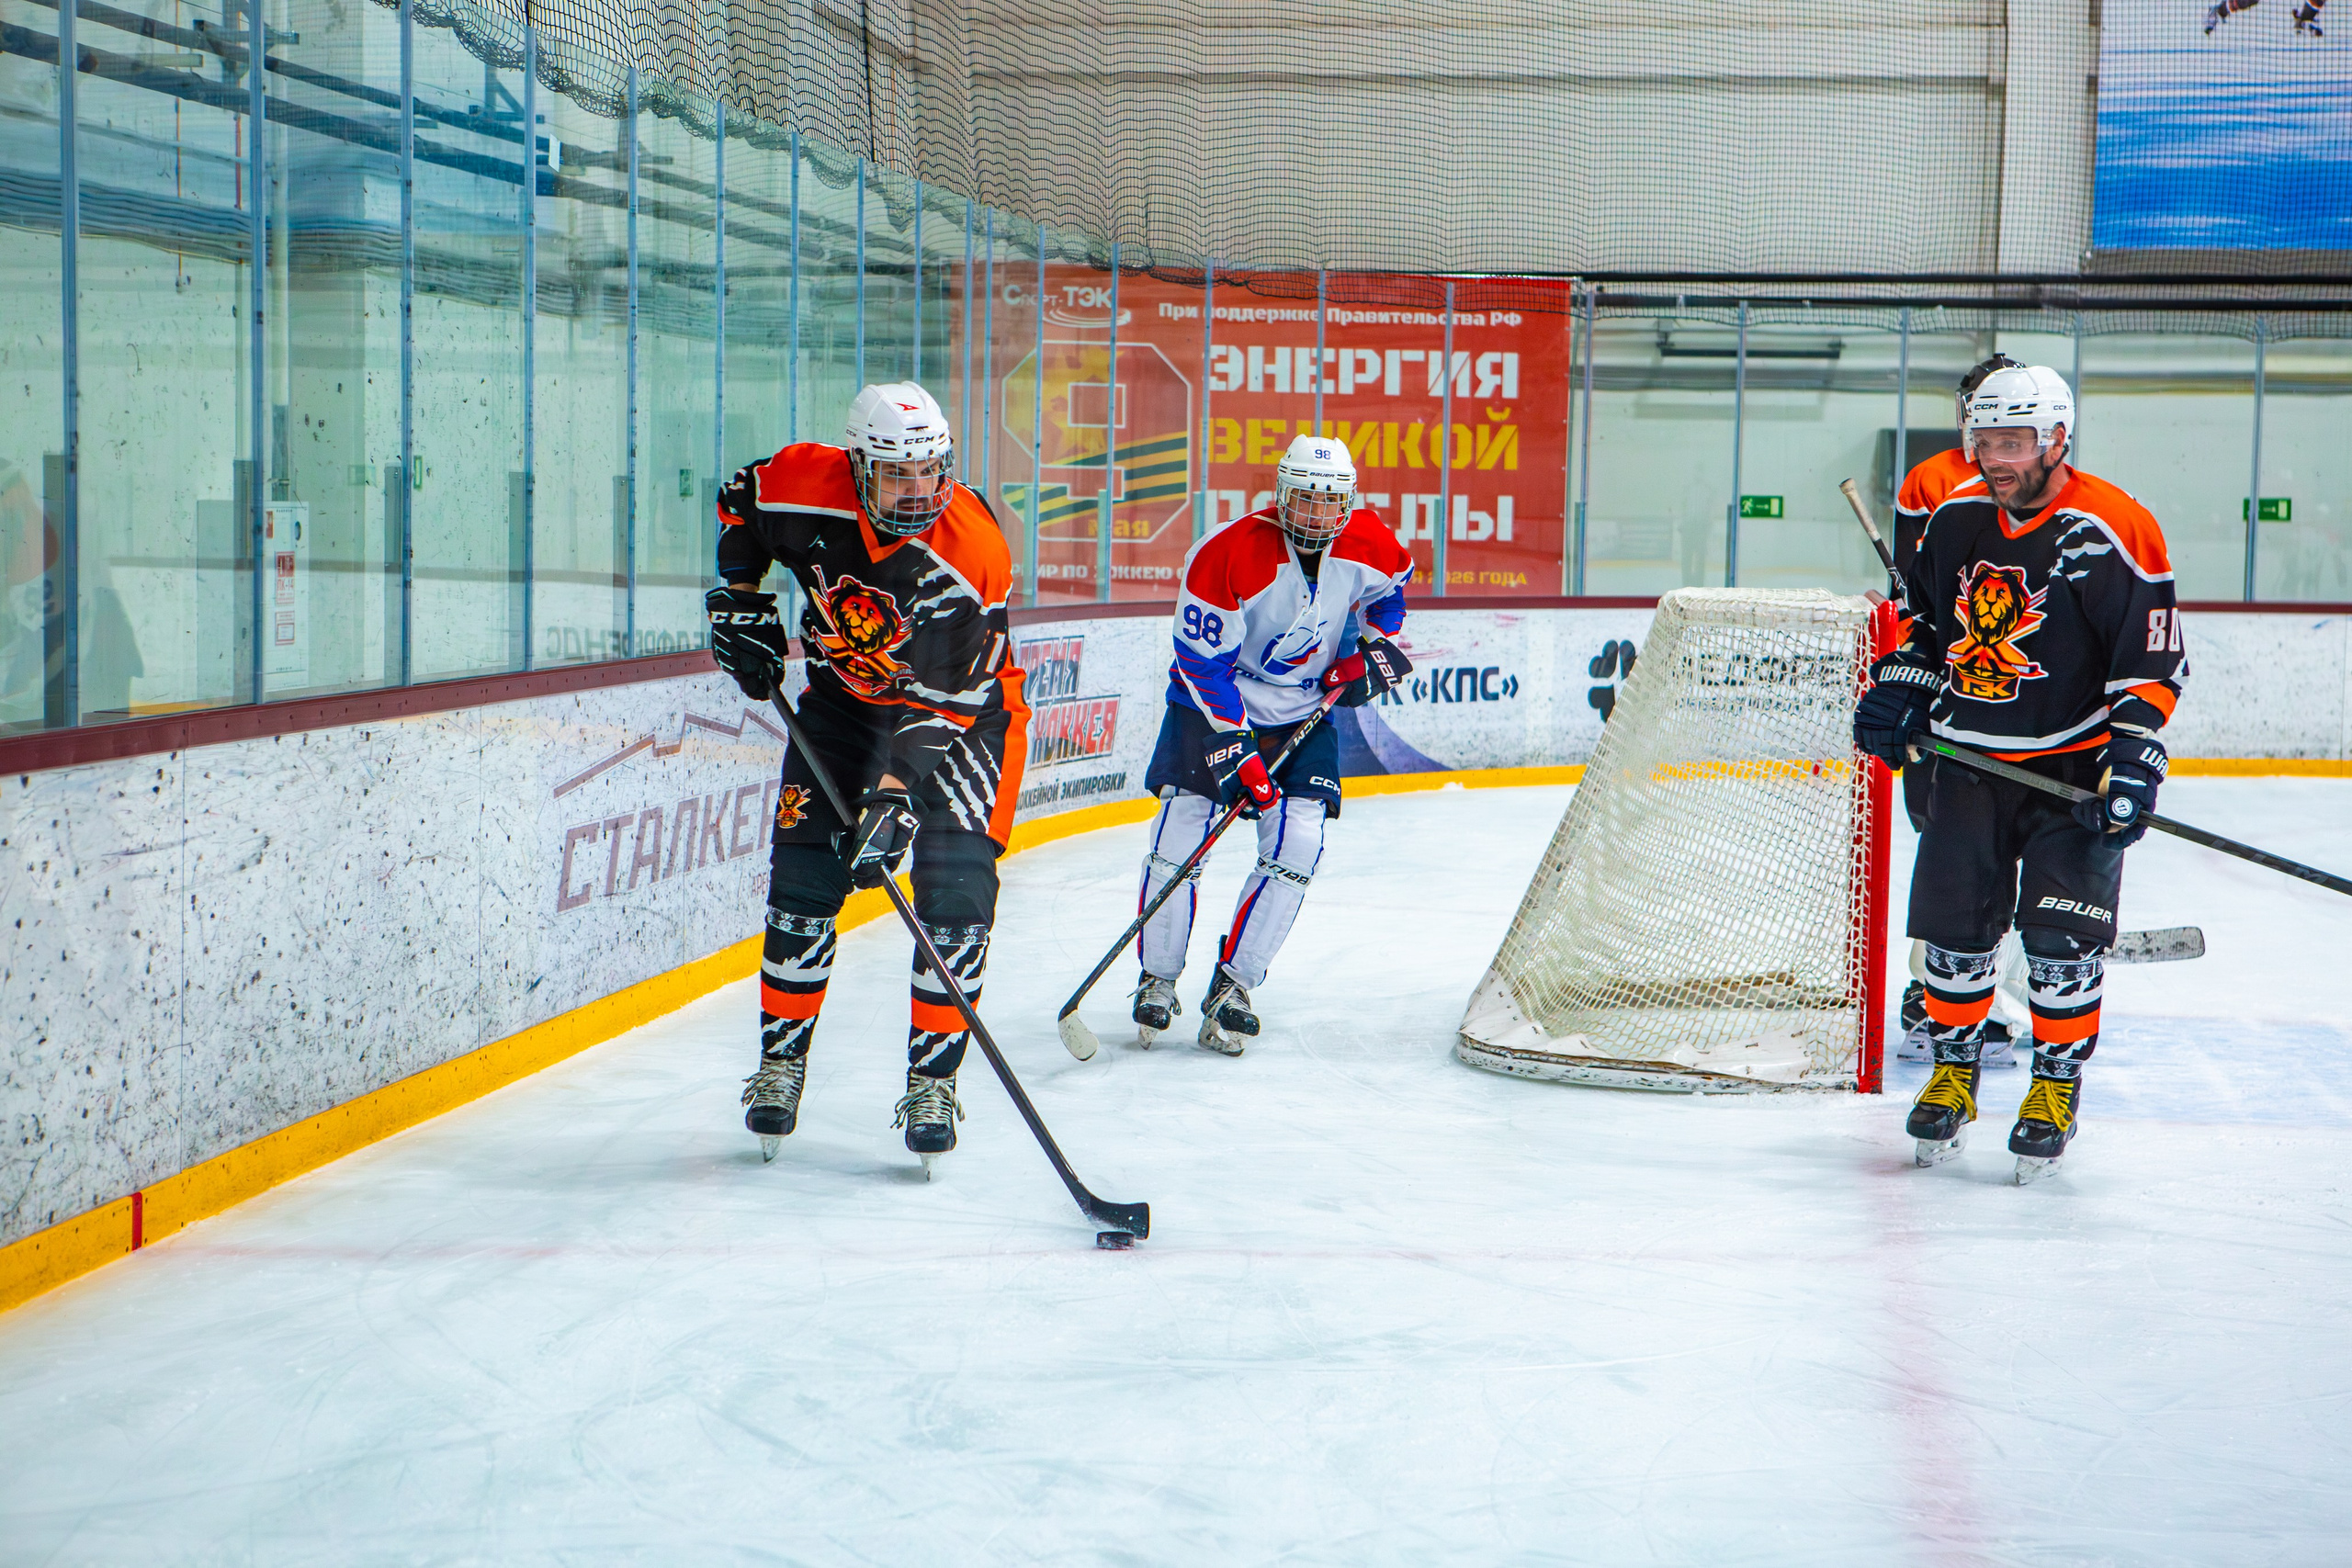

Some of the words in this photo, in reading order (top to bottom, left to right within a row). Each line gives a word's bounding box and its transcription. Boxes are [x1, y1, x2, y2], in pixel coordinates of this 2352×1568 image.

[1159, 302, 1198, 321] При
[1203, 306, 1320, 324] оддержке
[1326, 308, 1486, 326] Правительства
[1489, 310, 1522, 327] РФ
[1202, 344, 1519, 399] ЭНЕРГИЯ
[845, 428, 857, 438] CCM
[903, 435, 935, 446] CCM
[1314, 448, 1331, 460] 98
[1202, 490, 1514, 550] ПЕДЫ
[1063, 565, 1088, 579] ПО
[1094, 564, 1173, 581] ОККЕЮ
[1478, 570, 1527, 588] ГОДА
[709, 611, 780, 626] CCM
[1182, 603, 1225, 649] 98
[2146, 606, 2183, 652] 80
[1369, 649, 1399, 688] BAU
[1879, 664, 1943, 692] WARRI
[1411, 667, 1519, 704] «КПС»
[1294, 710, 1323, 747] CCM
[1204, 742, 1244, 767] UER
[1060, 772, 1126, 801] ЭКИПИРОВКИ
[1308, 775, 1341, 795] CCM
[2037, 896, 2113, 924] BAUER
